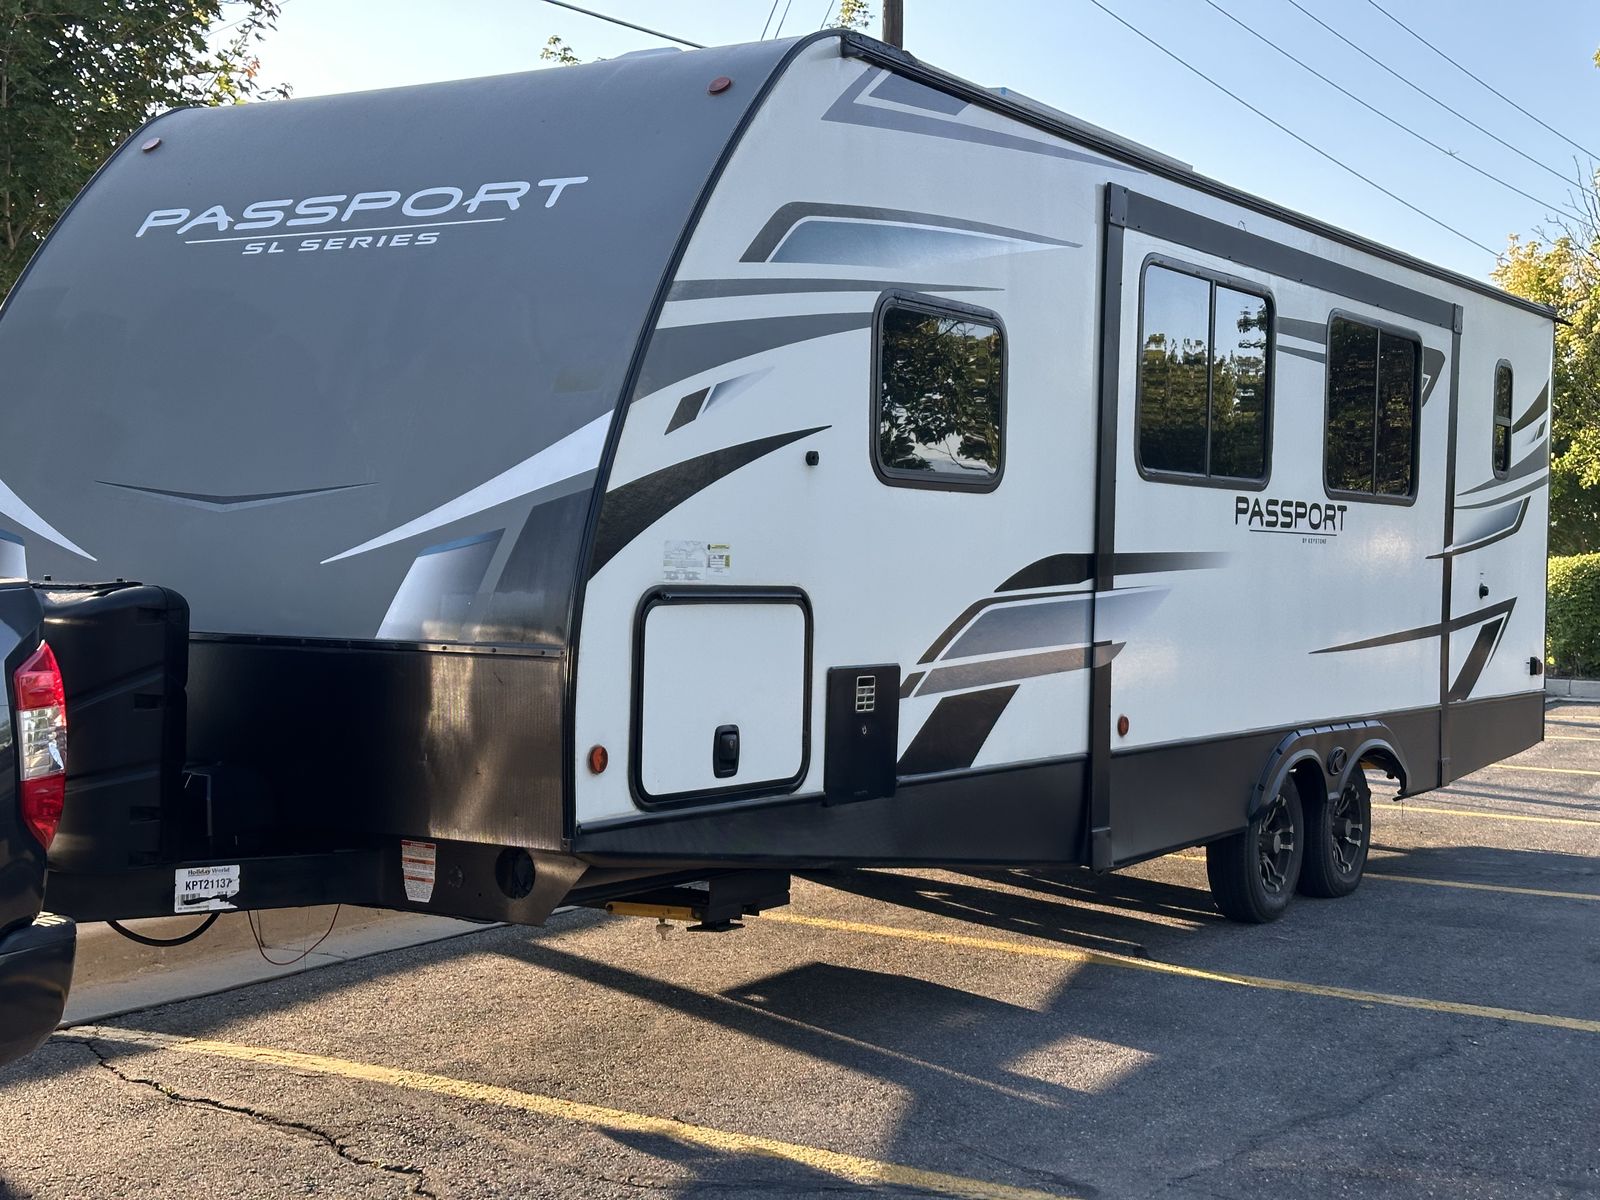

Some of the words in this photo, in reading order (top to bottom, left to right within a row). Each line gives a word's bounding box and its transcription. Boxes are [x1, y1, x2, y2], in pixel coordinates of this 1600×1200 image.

[135, 176, 589, 238] PASSPORT
[242, 242, 284, 255] SL
[298, 232, 440, 252] SERIES
[1235, 496, 1348, 531] PASSPORT
[185, 878, 232, 891] KPT21137
